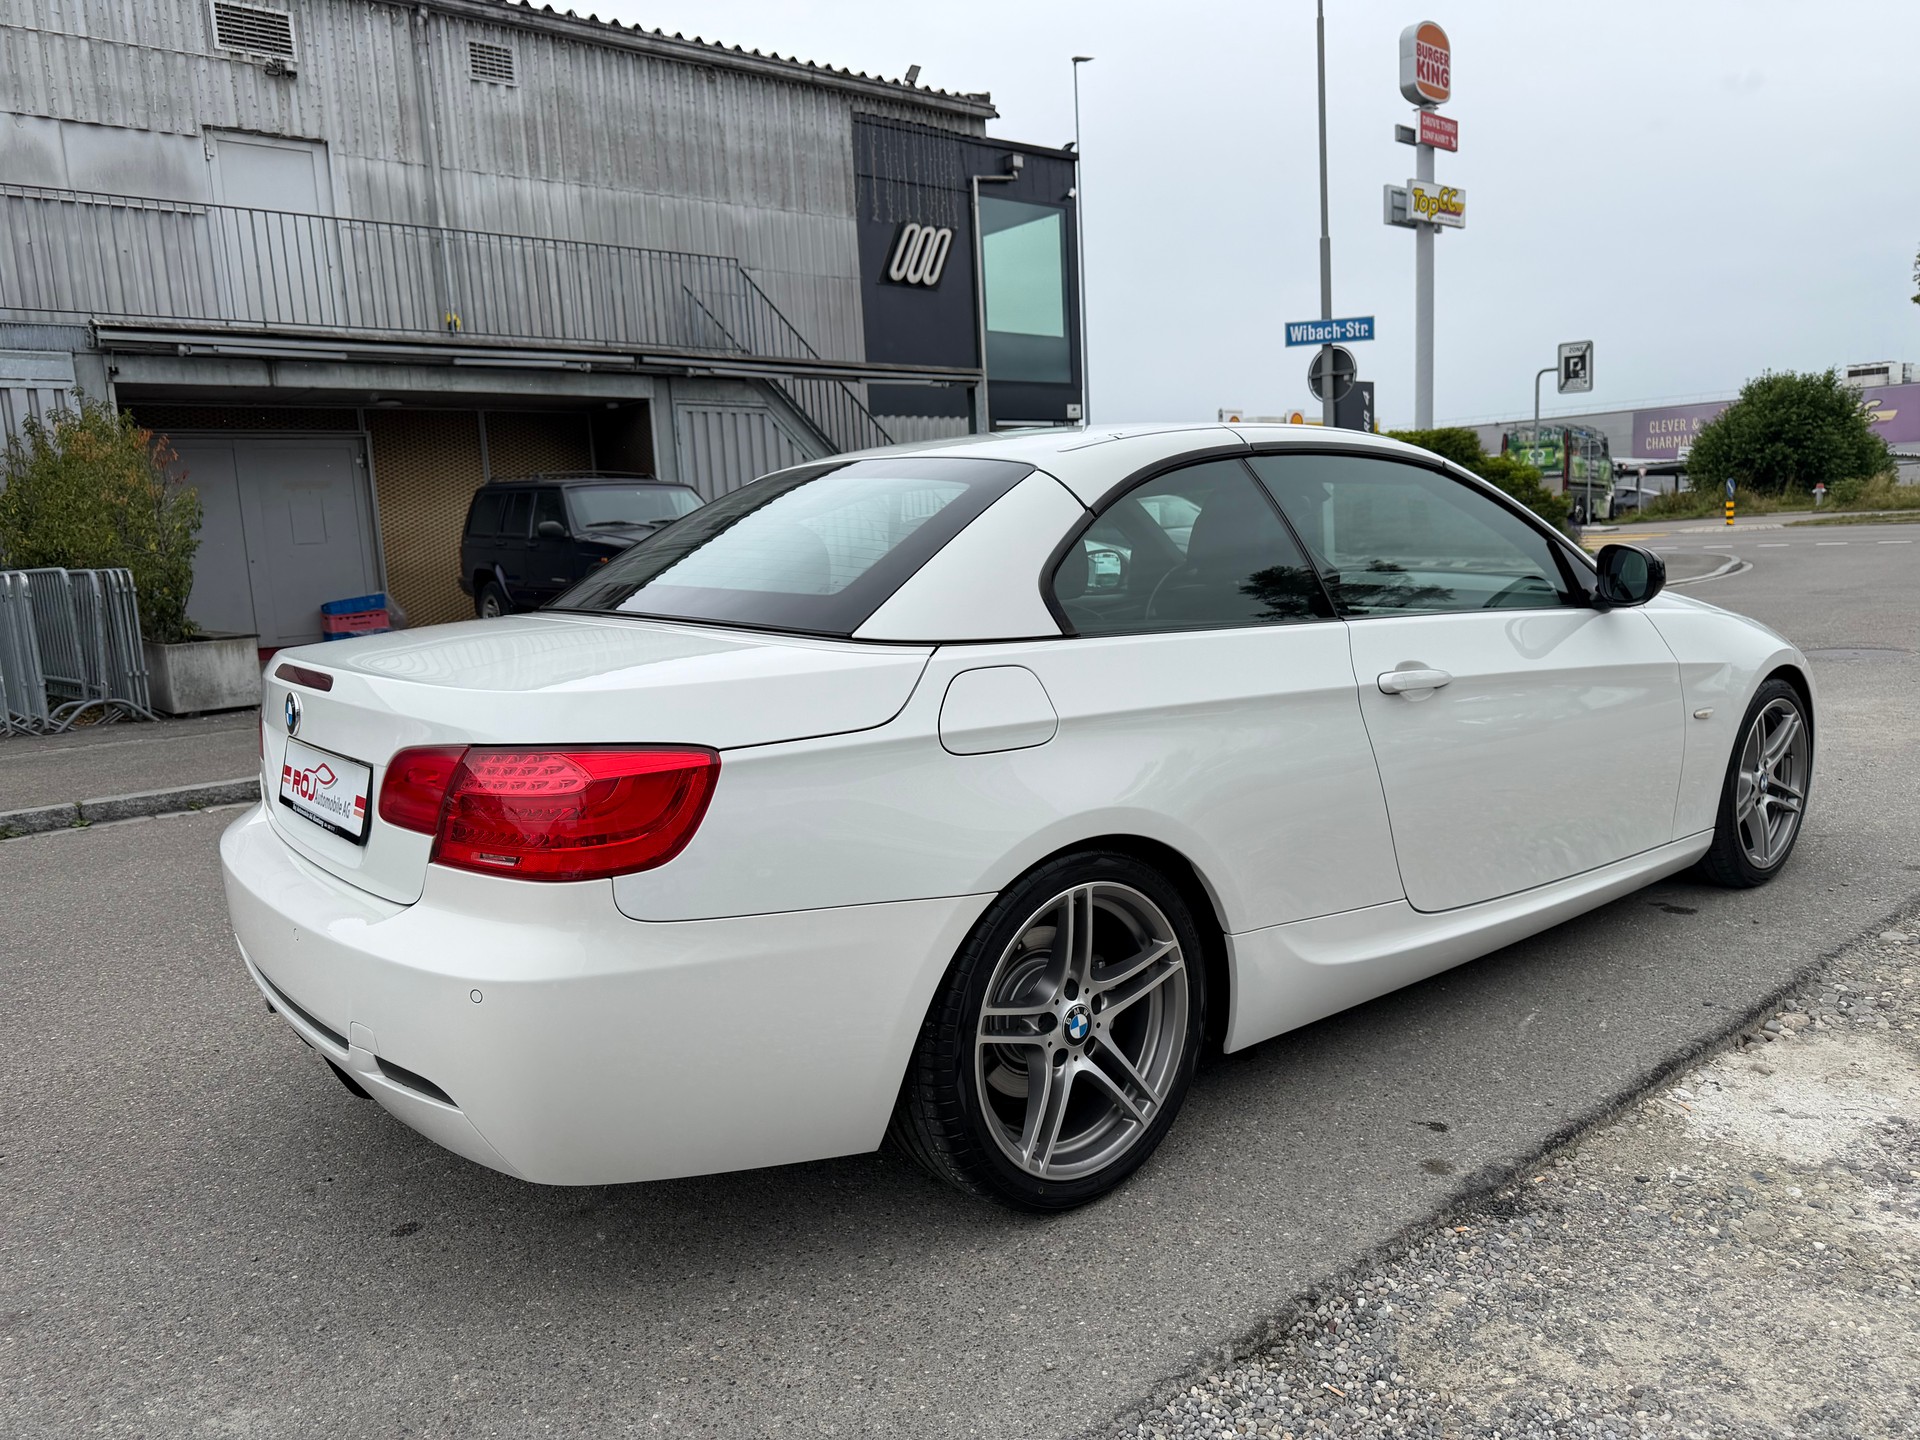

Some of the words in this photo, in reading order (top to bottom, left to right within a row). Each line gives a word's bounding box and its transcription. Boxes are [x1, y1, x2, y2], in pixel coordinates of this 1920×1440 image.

[1416, 42, 1449, 67] BURGER
[1416, 58, 1449, 88] KING
[1290, 321, 1369, 342] Wibach-Str.
[1649, 418, 1687, 434] CLEVER
[1645, 434, 1698, 450] CHARMAN
[314, 788, 342, 815] Automobile
[342, 801, 351, 818] AG
